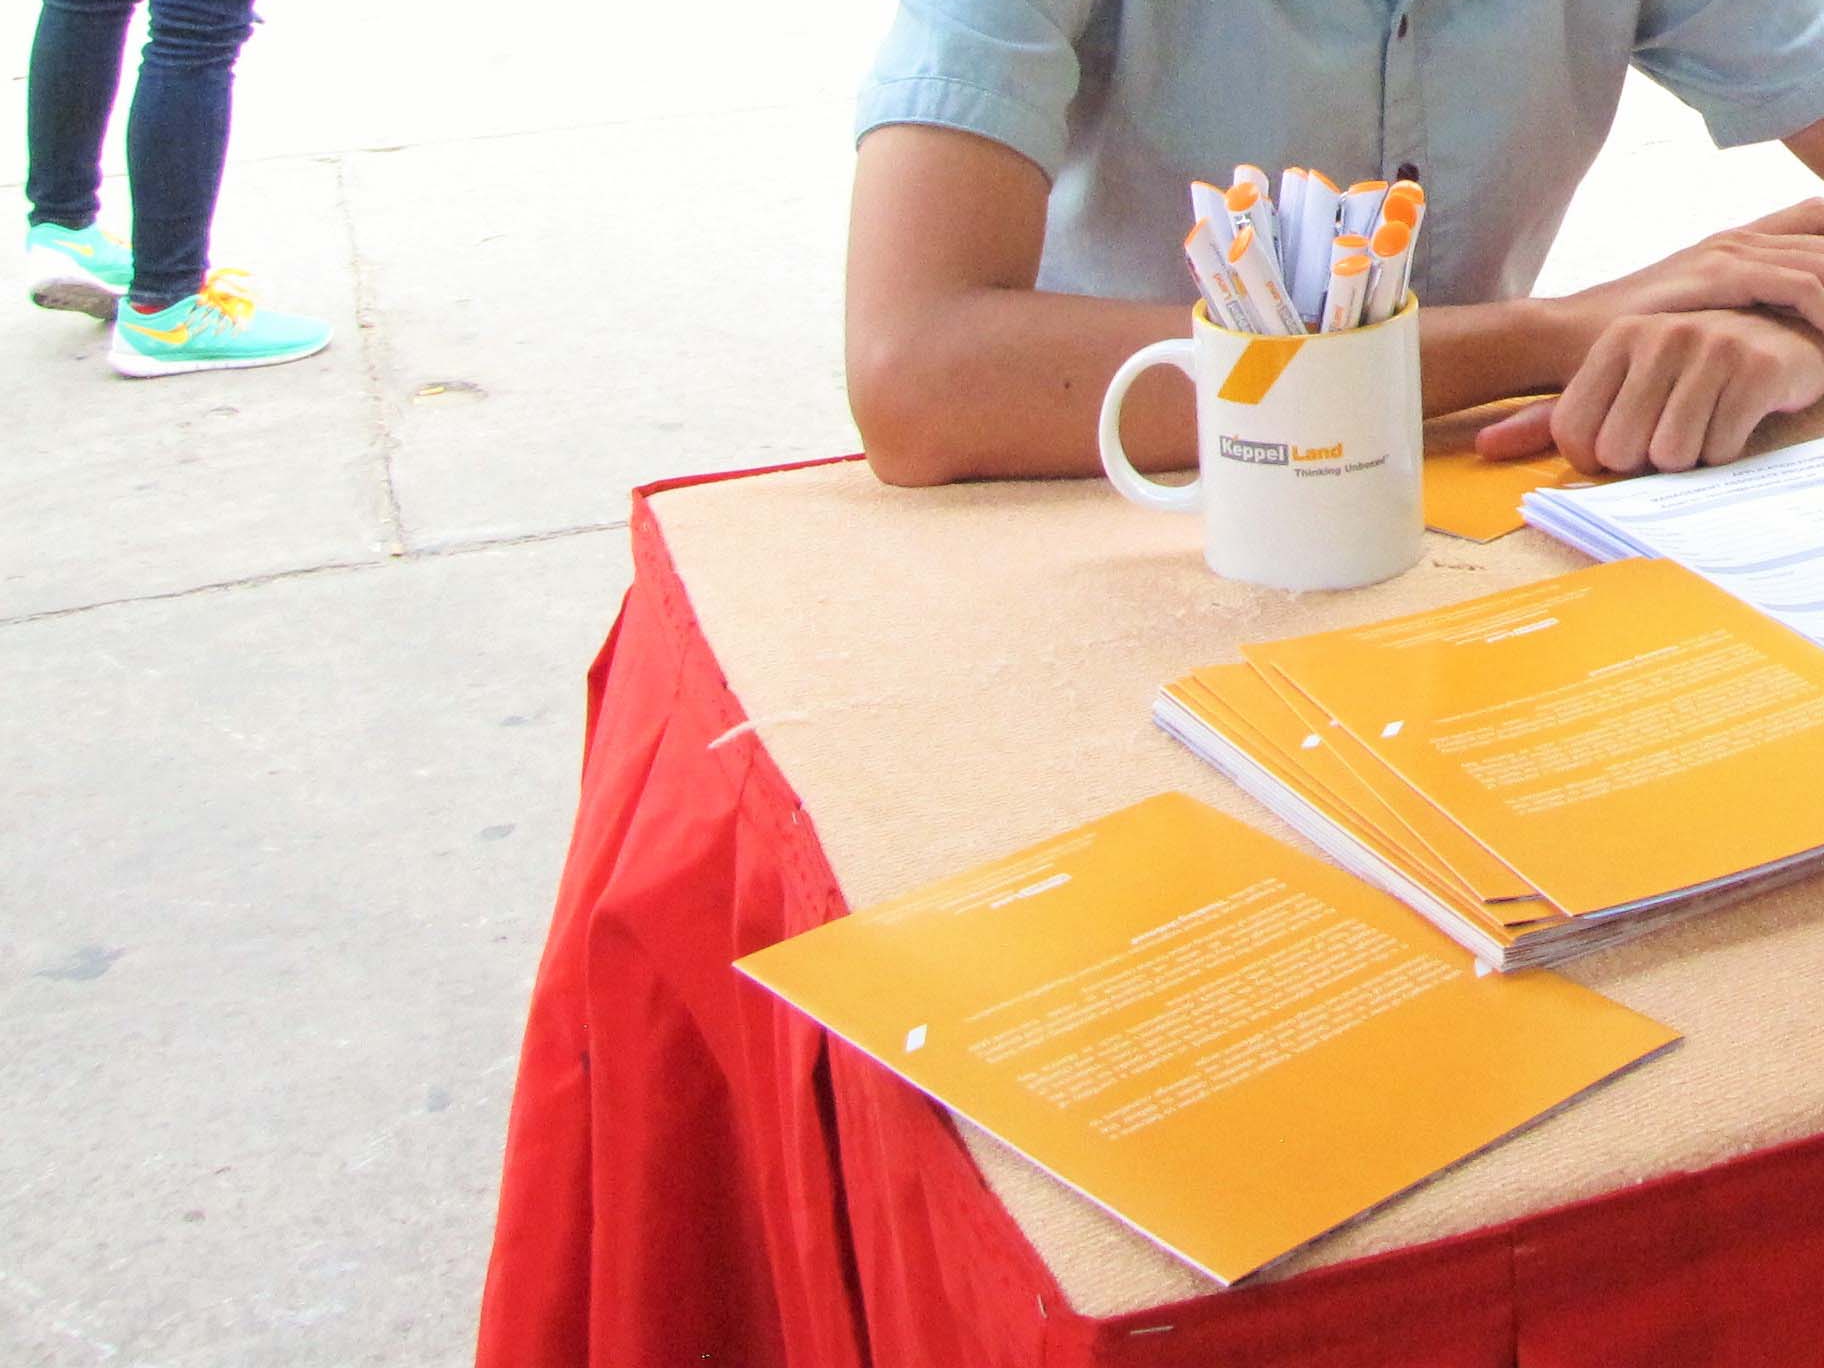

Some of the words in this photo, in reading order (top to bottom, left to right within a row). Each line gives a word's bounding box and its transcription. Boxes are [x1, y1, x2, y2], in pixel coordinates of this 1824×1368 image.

[1220, 436, 1287, 464] Keppel
[1291, 442, 1344, 462] Land
[1294, 466, 1342, 478] Thinking
